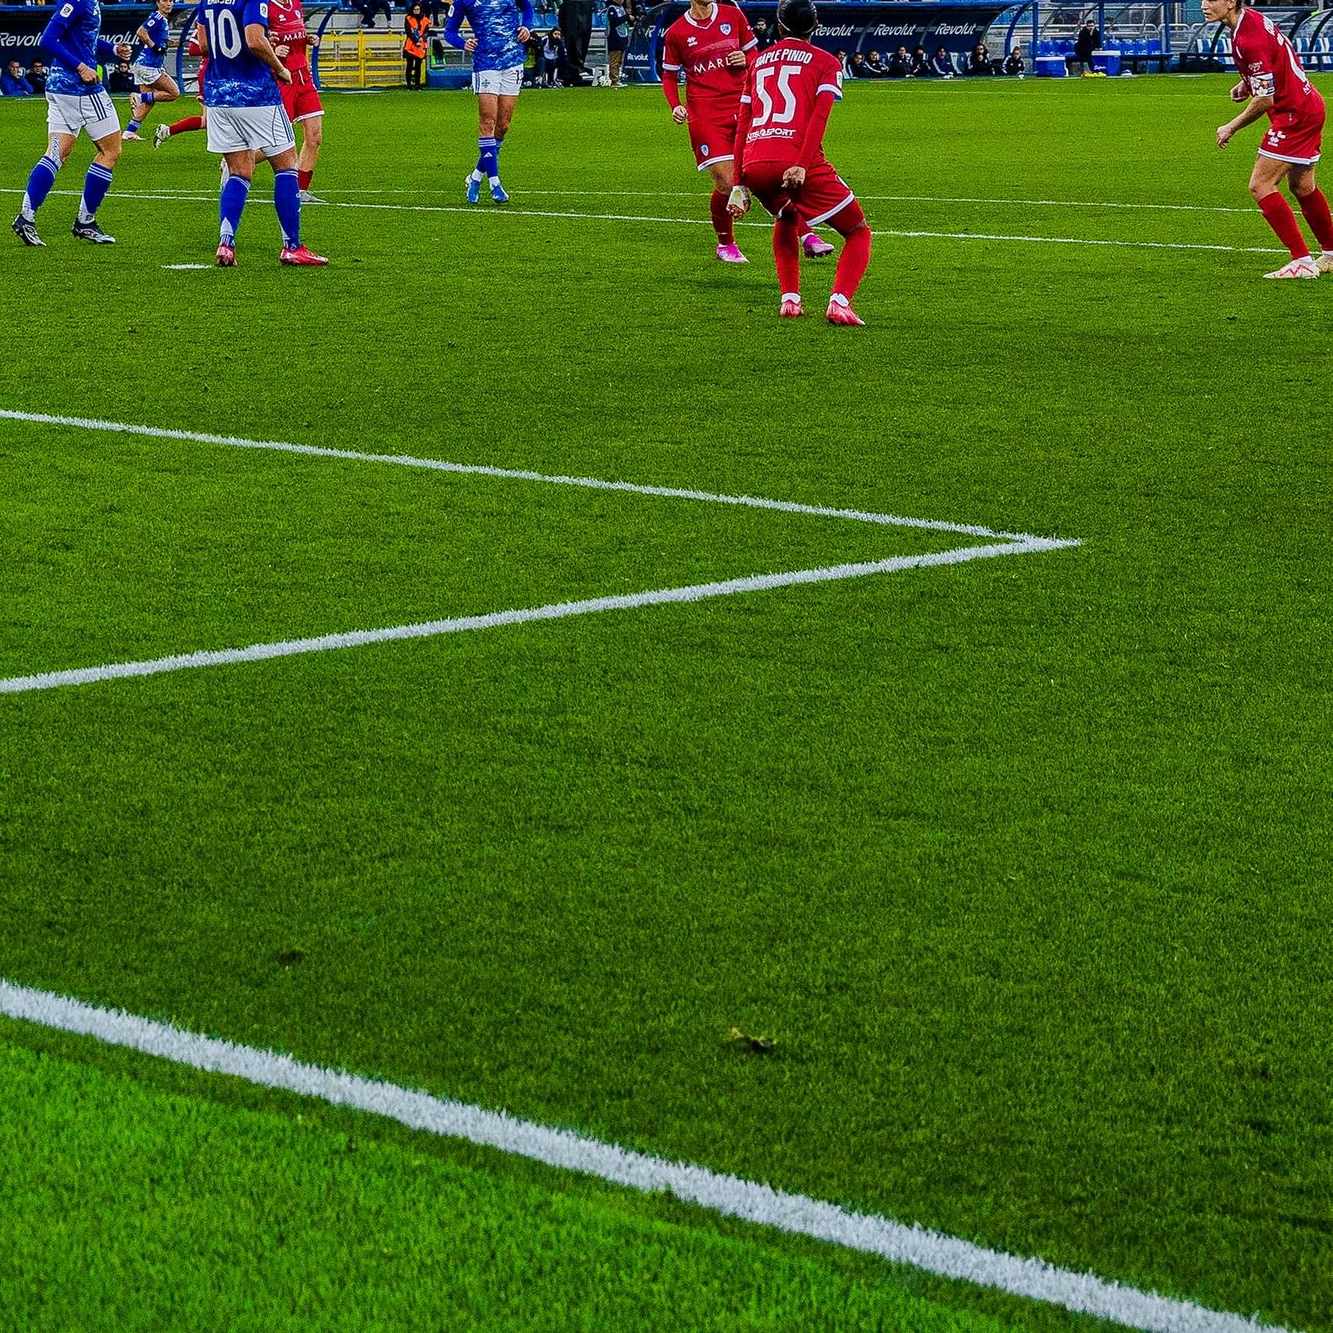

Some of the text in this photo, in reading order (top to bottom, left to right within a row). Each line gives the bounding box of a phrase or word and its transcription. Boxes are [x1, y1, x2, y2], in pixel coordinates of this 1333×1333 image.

[205, 9, 242, 60] 10
[811, 24, 855, 37] Revolut
[873, 24, 917, 37] Revolut
[934, 22, 977, 36] Revolut
[780, 48, 814, 65] PINDO
[751, 65, 803, 128] 55
